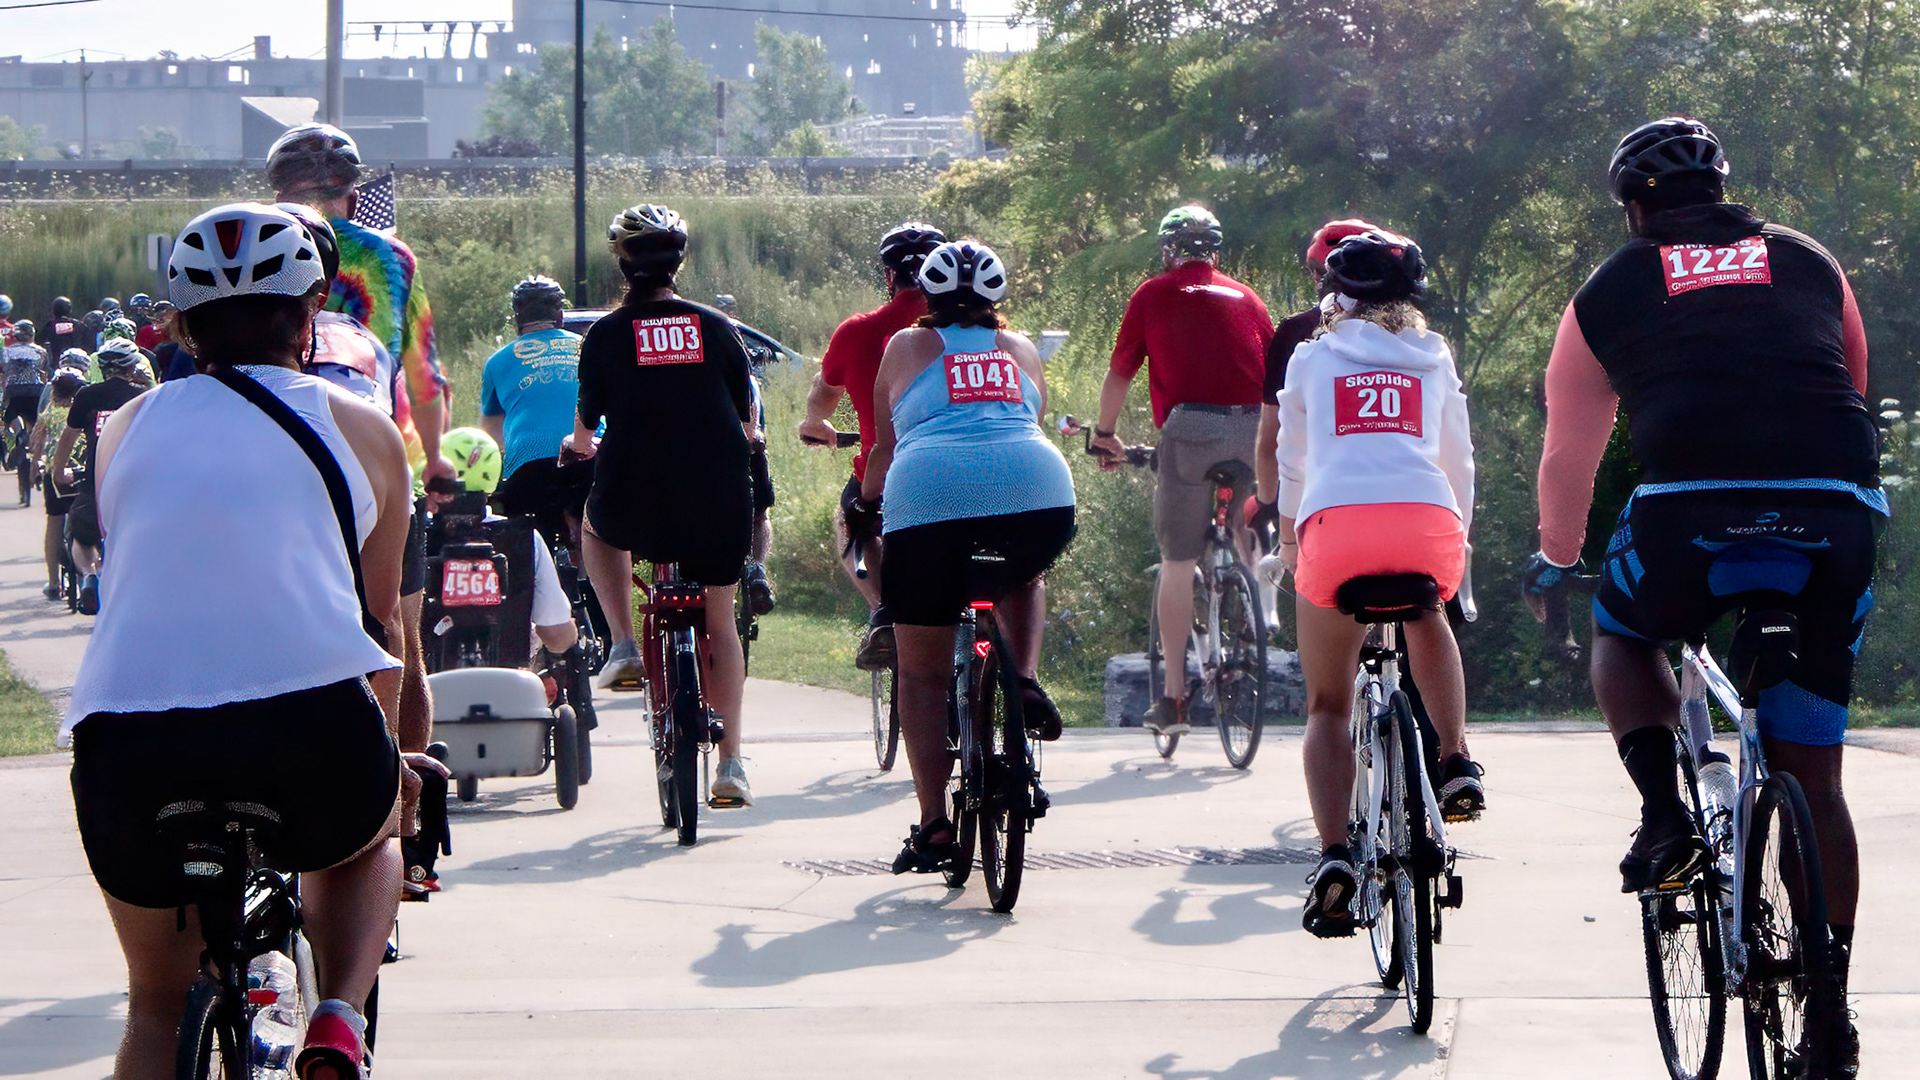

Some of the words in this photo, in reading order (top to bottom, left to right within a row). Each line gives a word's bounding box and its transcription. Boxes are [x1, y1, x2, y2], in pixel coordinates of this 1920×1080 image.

[1668, 246, 1766, 279] 1222
[639, 326, 700, 352] 1003
[950, 362, 1019, 389] 1041
[1345, 373, 1412, 388] SkyRide
[1358, 388, 1401, 418] 20
[444, 572, 499, 596] 4564
